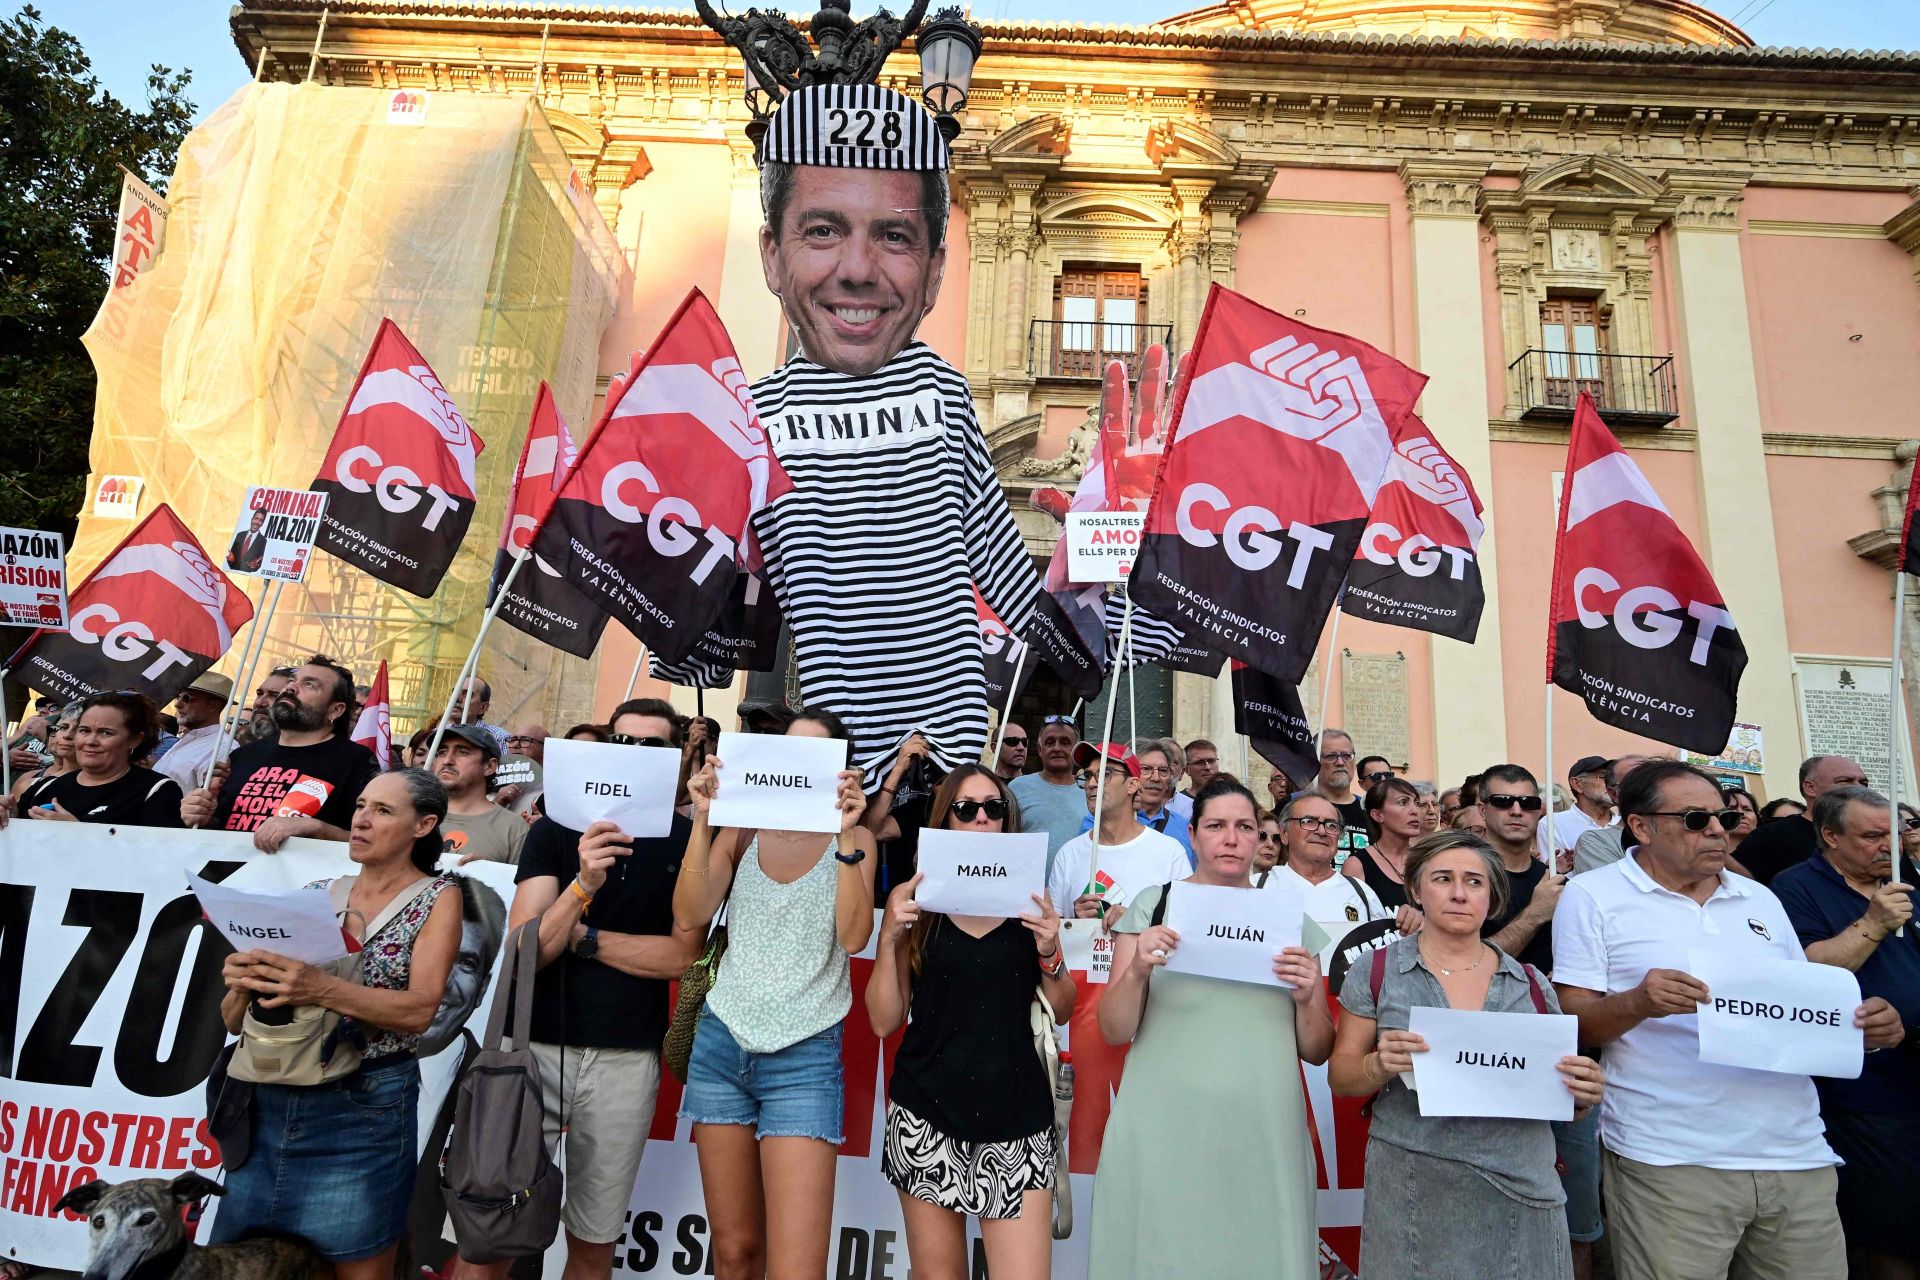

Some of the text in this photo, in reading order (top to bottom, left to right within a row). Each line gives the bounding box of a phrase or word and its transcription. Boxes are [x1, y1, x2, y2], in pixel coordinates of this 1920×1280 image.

[829, 109, 902, 149] 228
[127, 184, 168, 220] ANDAMIOS
[458, 346, 535, 368] TEMPLO
[250, 488, 322, 518] CRIMINAL
[335, 445, 460, 532] CGT
[264, 514, 317, 544] MAZÓN
[601, 461, 735, 586] CGT
[1080, 518, 1140, 526] NOSALTRES
[1176, 482, 1335, 591] CGT
[0, 533, 59, 560] AZÓN
[328, 532, 388, 569] VALÈNCIA
[367, 540, 419, 570] SINDICATOS
[1078, 548, 1104, 556] ELLS
[1107, 548, 1127, 556] PER
[1360, 522, 1473, 581] CGT
[570, 537, 676, 630] FEDERACIÓN SINDICATOS
[581, 567, 643, 624] VALÈNCIA
[9, 602, 38, 611] NOSTRES
[502, 600, 550, 631] ALÈNCIA
[1157, 572, 1287, 646] FEDERACIÓN SINDICATOS
[1347, 585, 1458, 617] FEDERACIÓN SINDICATOS
[1365, 602, 1429, 621] VALÈNCIA
[41, 616, 61, 626] CGT
[533, 603, 579, 631] SINDICATOS
[1176, 600, 1250, 648] VALÈNCIA
[1573, 567, 1736, 667] CGT
[69, 603, 194, 681] CGT
[1053, 628, 1090, 669] SINDICATOS
[1177, 645, 1209, 658] SINDICATOS
[31, 654, 80, 687] FEDERACIÓN
[1164, 652, 1190, 664] ÈNCIA
[1583, 686, 1652, 724] ALÈNCIA
[1615, 685, 1696, 719] SINDICATOS
[239, 782, 287, 798] ES EL
[248, 766, 299, 785] ARA
[584, 781, 632, 797] FIDEL
[744, 772, 813, 789] MANUEL
[232, 795, 282, 815] MOM
[225, 813, 268, 832] ENT
[957, 863, 1008, 878] MARÍA
[228, 920, 292, 939] ÁNGEL
[1206, 924, 1265, 943] JULIÁN
[1715, 998, 1841, 1027] PEDRO JOSÉ
[1456, 1050, 1526, 1070] JULIÁN
[21, 1105, 223, 1169] NOSTRES
